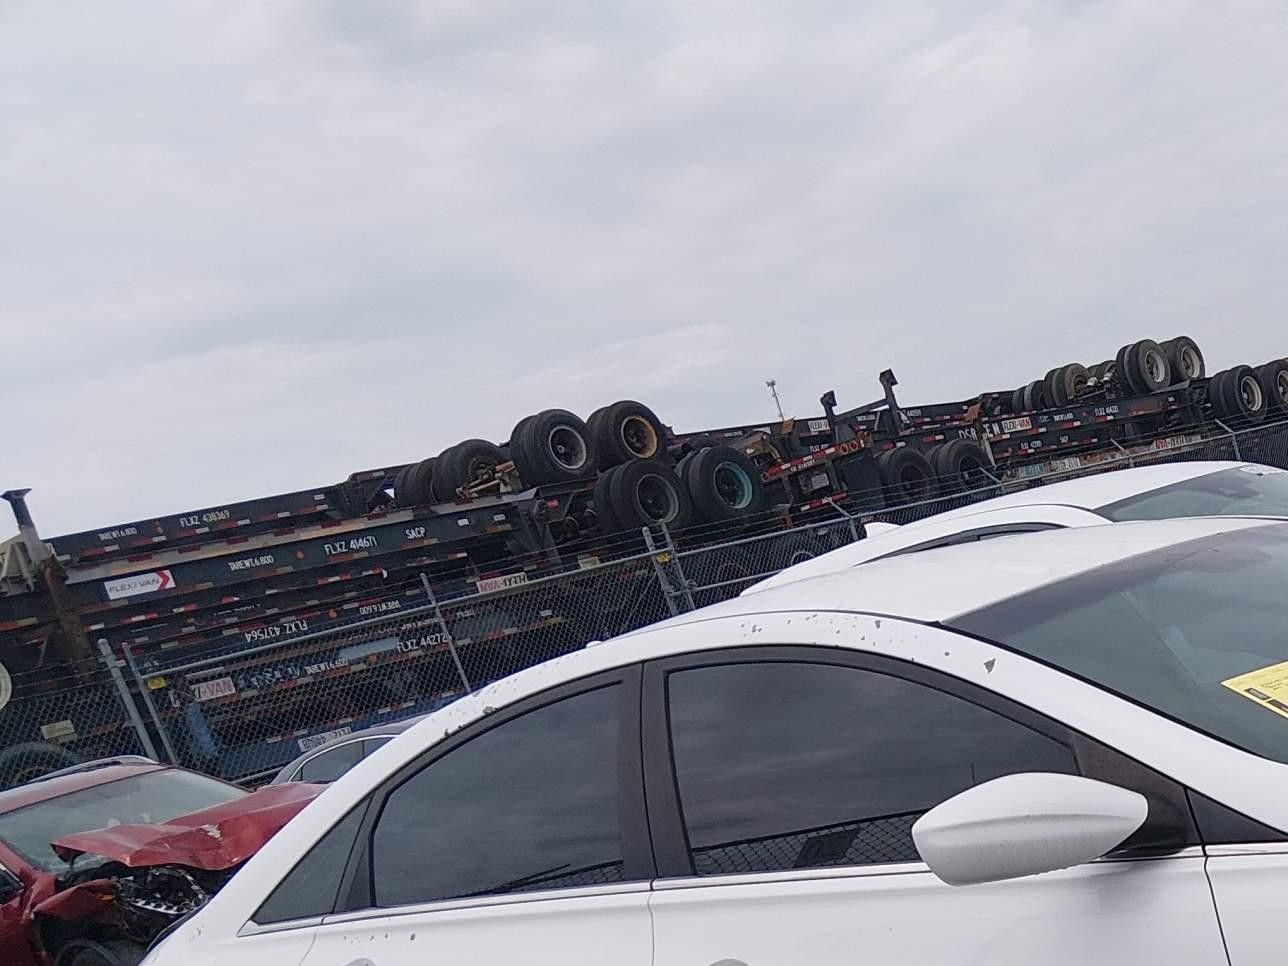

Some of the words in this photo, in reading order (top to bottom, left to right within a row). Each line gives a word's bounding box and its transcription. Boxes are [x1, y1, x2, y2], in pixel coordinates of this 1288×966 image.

[808, 420, 829, 431] FLEXI-V
[179, 515, 201, 528] FLXZ
[405, 526, 426, 540] SACP
[323, 541, 349, 556] FLXZ
[349, 536, 378, 551] 414671
[284, 619, 308, 634] FLXZ
[396, 639, 419, 653] FLXZ
[419, 632, 453, 648] 44272
